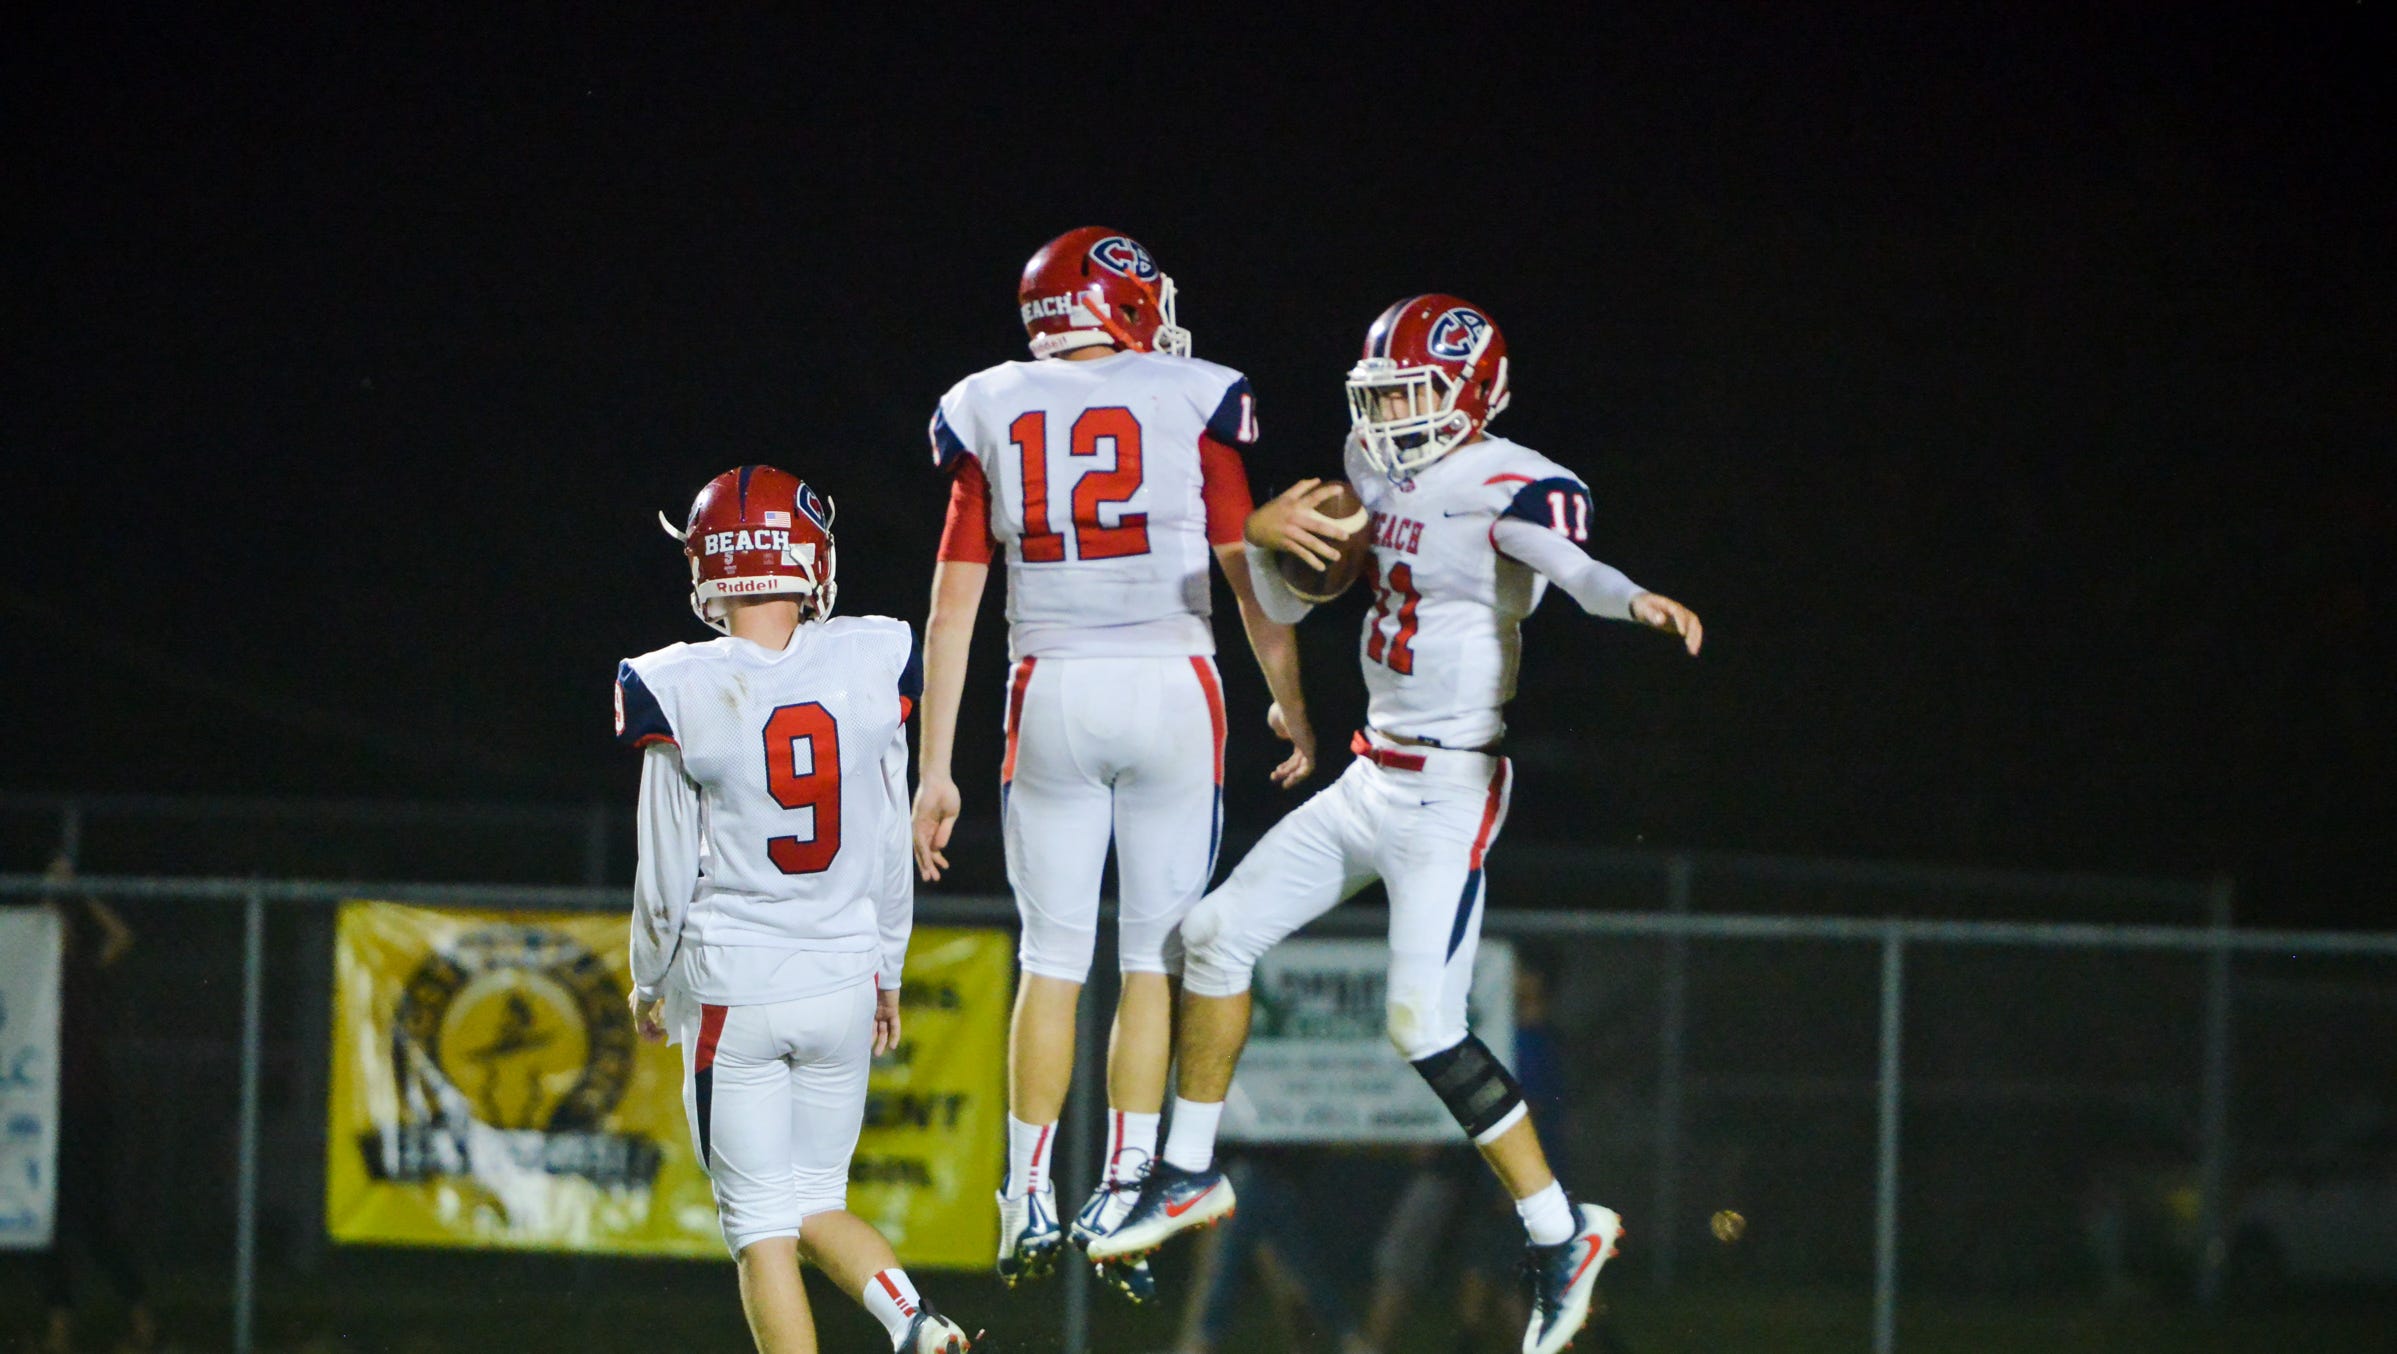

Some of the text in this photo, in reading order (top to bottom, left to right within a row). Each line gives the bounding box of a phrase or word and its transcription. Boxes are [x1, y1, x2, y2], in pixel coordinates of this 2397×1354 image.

[1021, 295, 1073, 325] EACH
[1009, 406, 1151, 563] 12
[1370, 510, 1425, 555] EACH
[1547, 491, 1589, 542] 11
[704, 530, 791, 556] BEACH
[717, 579, 778, 594] Riddell
[762, 701, 841, 875] 9
